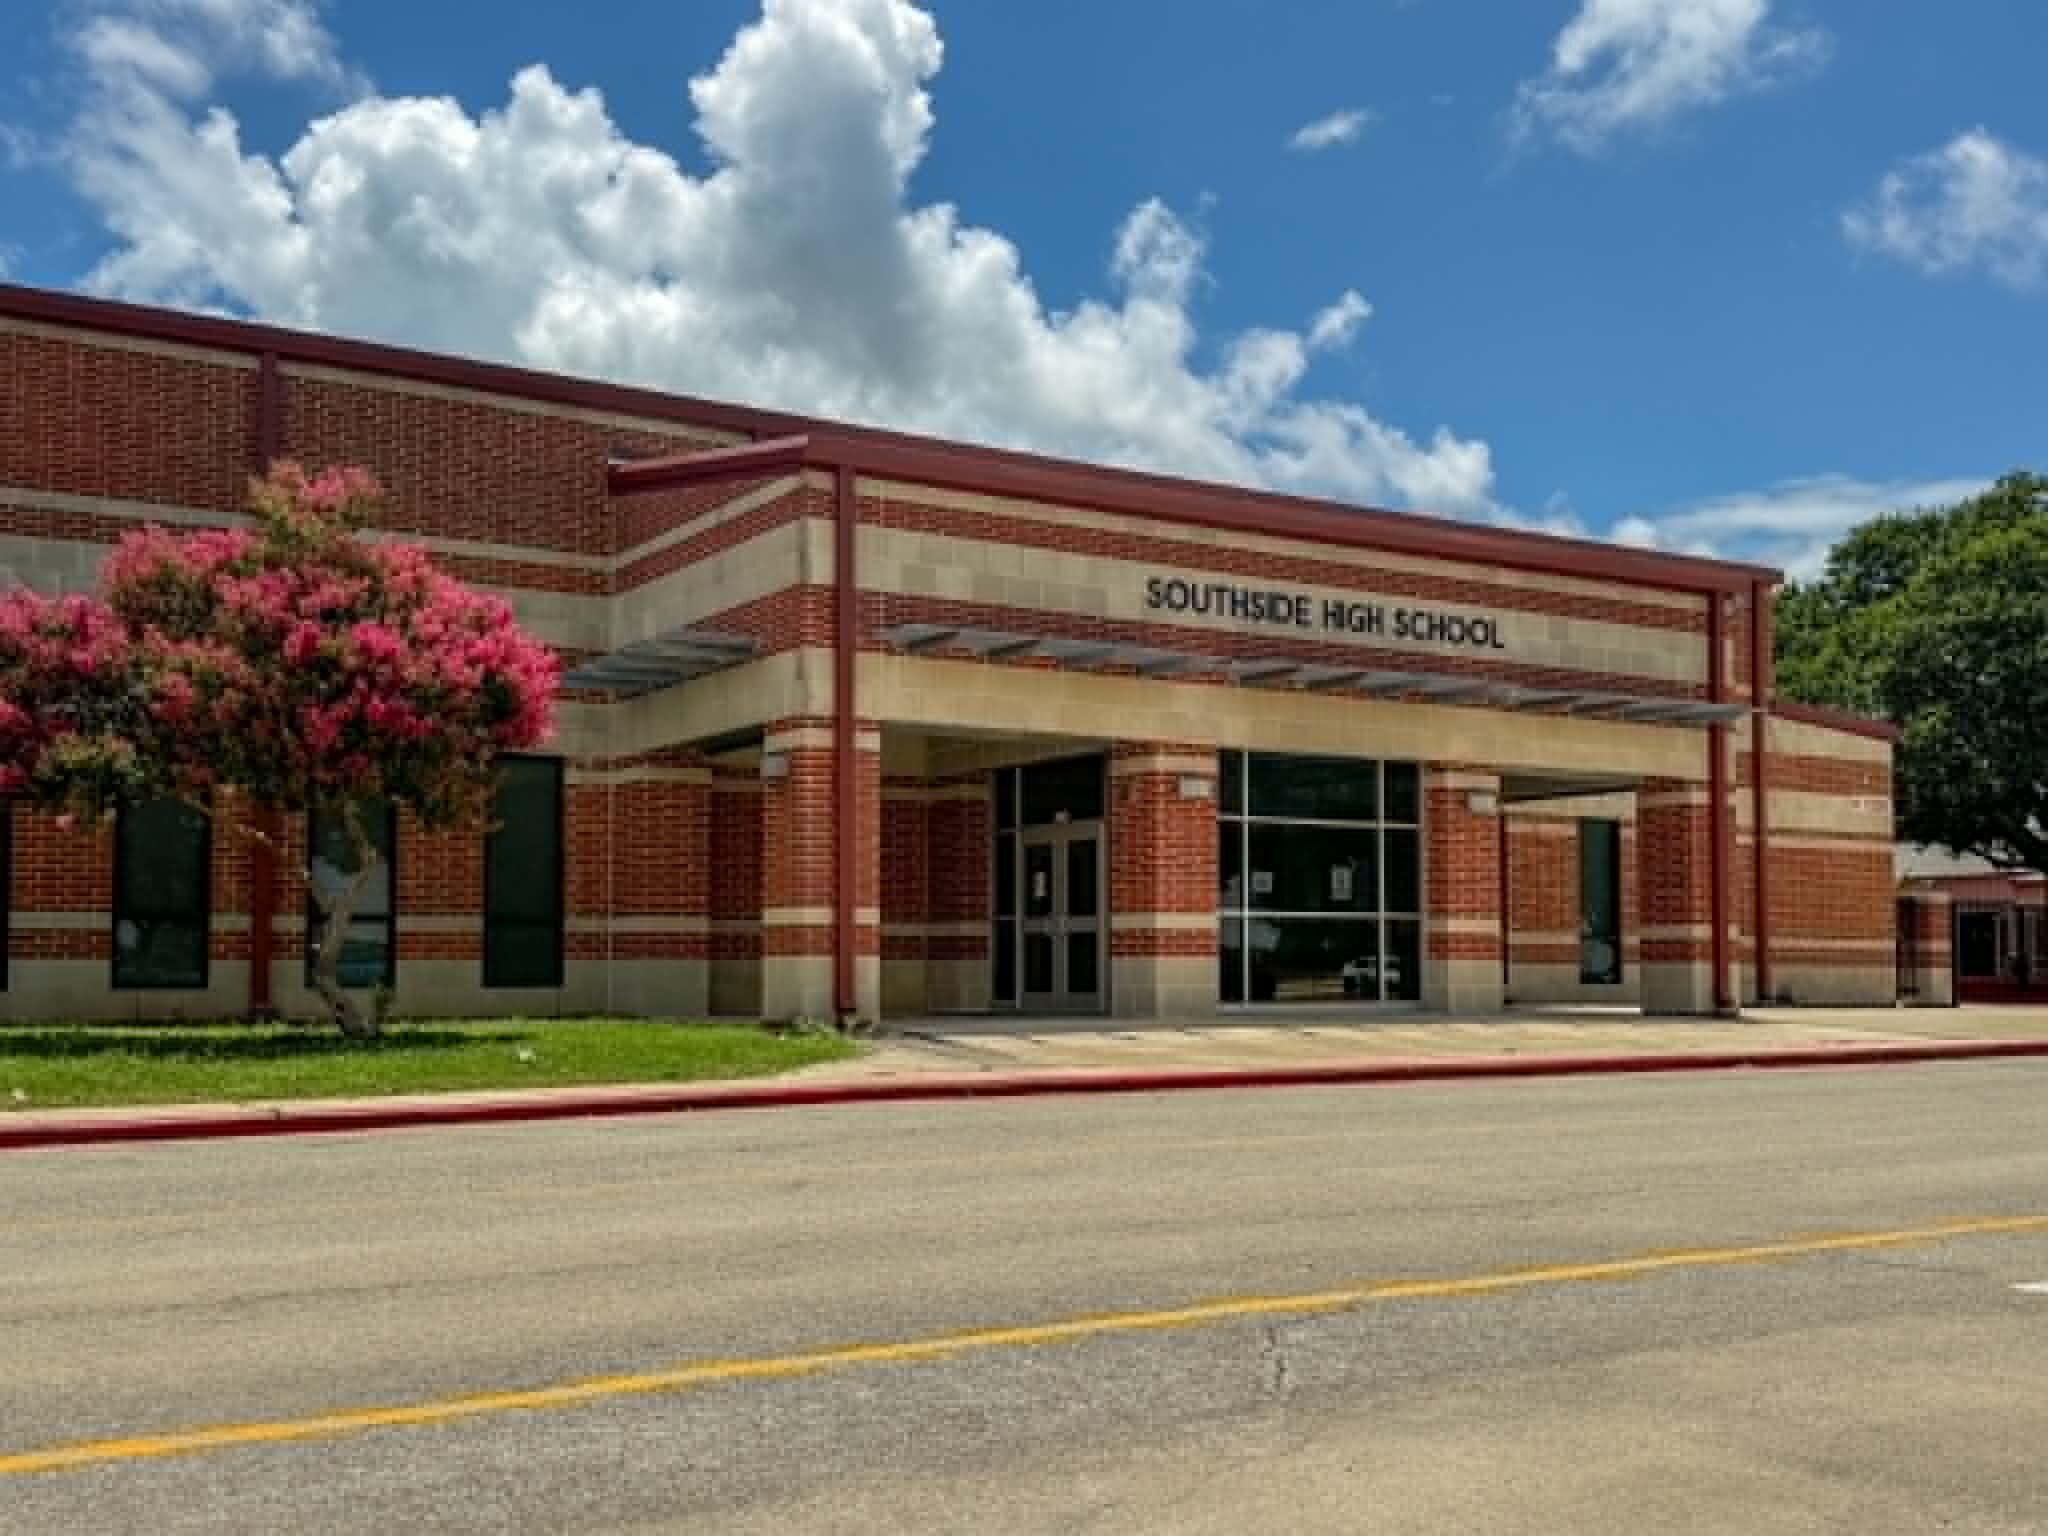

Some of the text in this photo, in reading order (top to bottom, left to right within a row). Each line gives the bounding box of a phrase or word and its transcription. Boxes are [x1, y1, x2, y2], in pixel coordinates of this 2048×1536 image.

[1146, 577, 1505, 649] SOUTHSIDE HIGH SCHOOL
